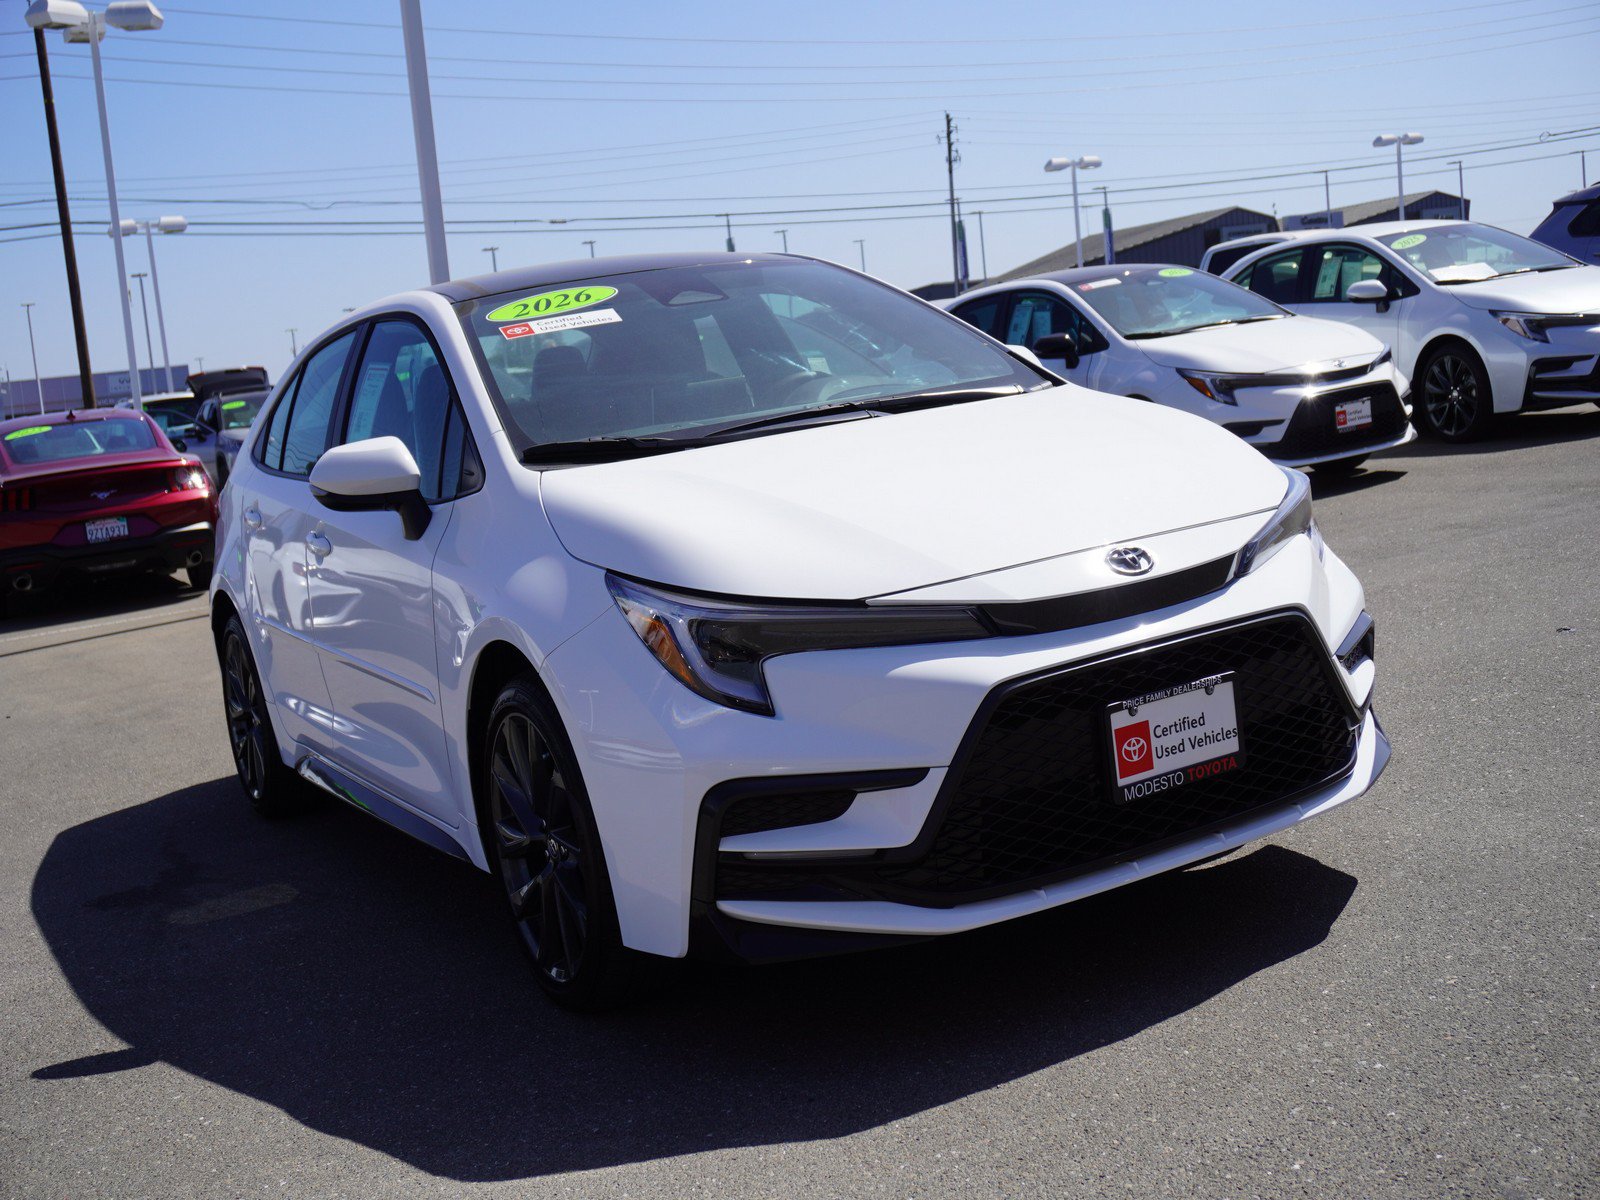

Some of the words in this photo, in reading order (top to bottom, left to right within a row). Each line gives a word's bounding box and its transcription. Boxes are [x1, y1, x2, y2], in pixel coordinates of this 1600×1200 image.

[513, 288, 592, 319] 2026
[536, 315, 583, 326] Certified
[539, 323, 568, 331] Used
[569, 317, 613, 326] Vehicles
[1122, 696, 1145, 710] PRICE
[1145, 689, 1172, 703] FAMILY
[1173, 675, 1222, 695] DEALERSHIPS
[1153, 712, 1206, 738] Certified
[1155, 738, 1186, 760] Used
[1188, 727, 1238, 750] Vehicles
[1124, 771, 1184, 802] MODESTO
[1188, 756, 1237, 781] TOYOTA
